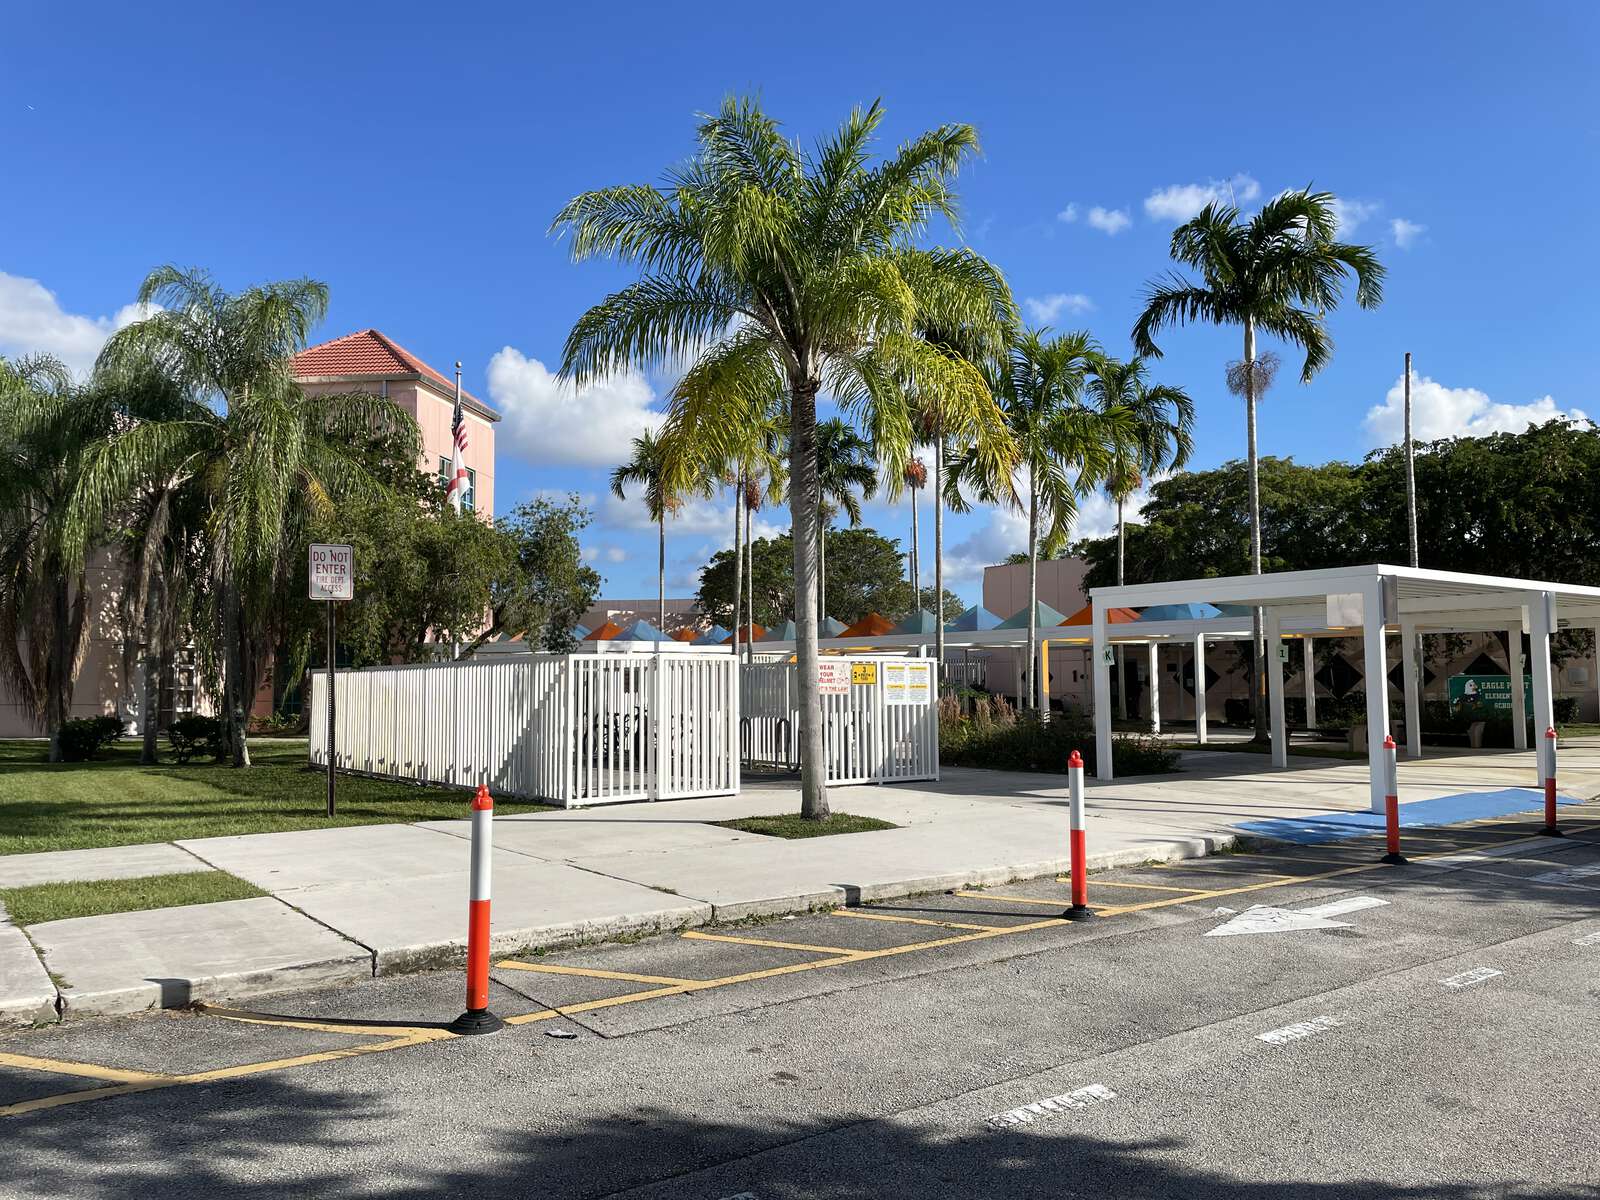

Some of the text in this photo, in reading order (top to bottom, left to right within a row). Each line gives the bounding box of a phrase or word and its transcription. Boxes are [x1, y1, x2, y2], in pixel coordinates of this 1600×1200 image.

[313, 551, 348, 562] DO NOT
[316, 563, 346, 575] ENTER
[316, 576, 328, 584] FIRE
[320, 584, 343, 592] ACCESS
[1105, 650, 1111, 661] K
[1280, 650, 1285, 658] 1
